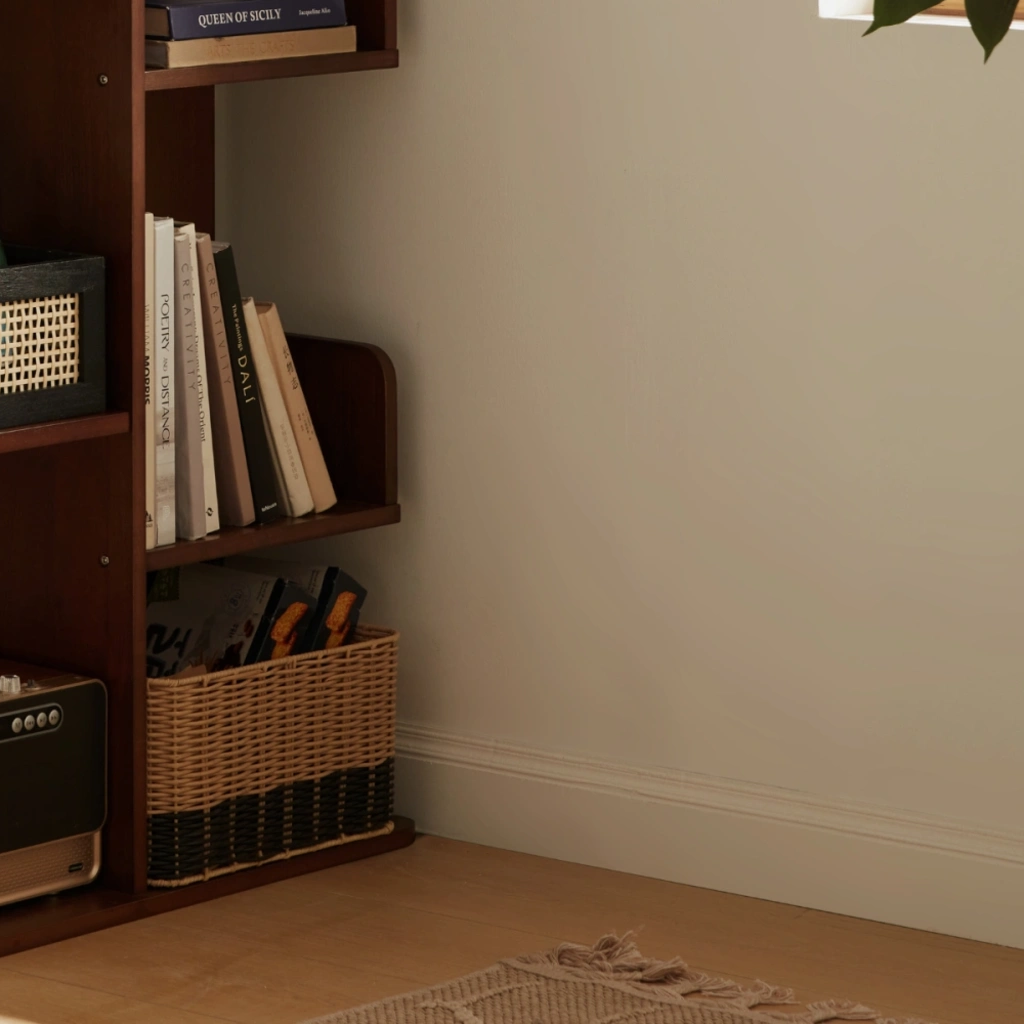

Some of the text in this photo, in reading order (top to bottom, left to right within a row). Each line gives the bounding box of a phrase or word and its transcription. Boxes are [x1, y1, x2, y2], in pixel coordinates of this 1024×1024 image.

[198, 8, 282, 28] QUEEN OF SICILY
[298, 9, 320, 17] Jacqueline
[160, 294, 170, 351] POETRY
[180, 262, 196, 391] CREATIVITY
[206, 262, 231, 385] CREATIVITY
[233, 318, 244, 352] Paintings
[161, 376, 170, 449] DISTANCE
